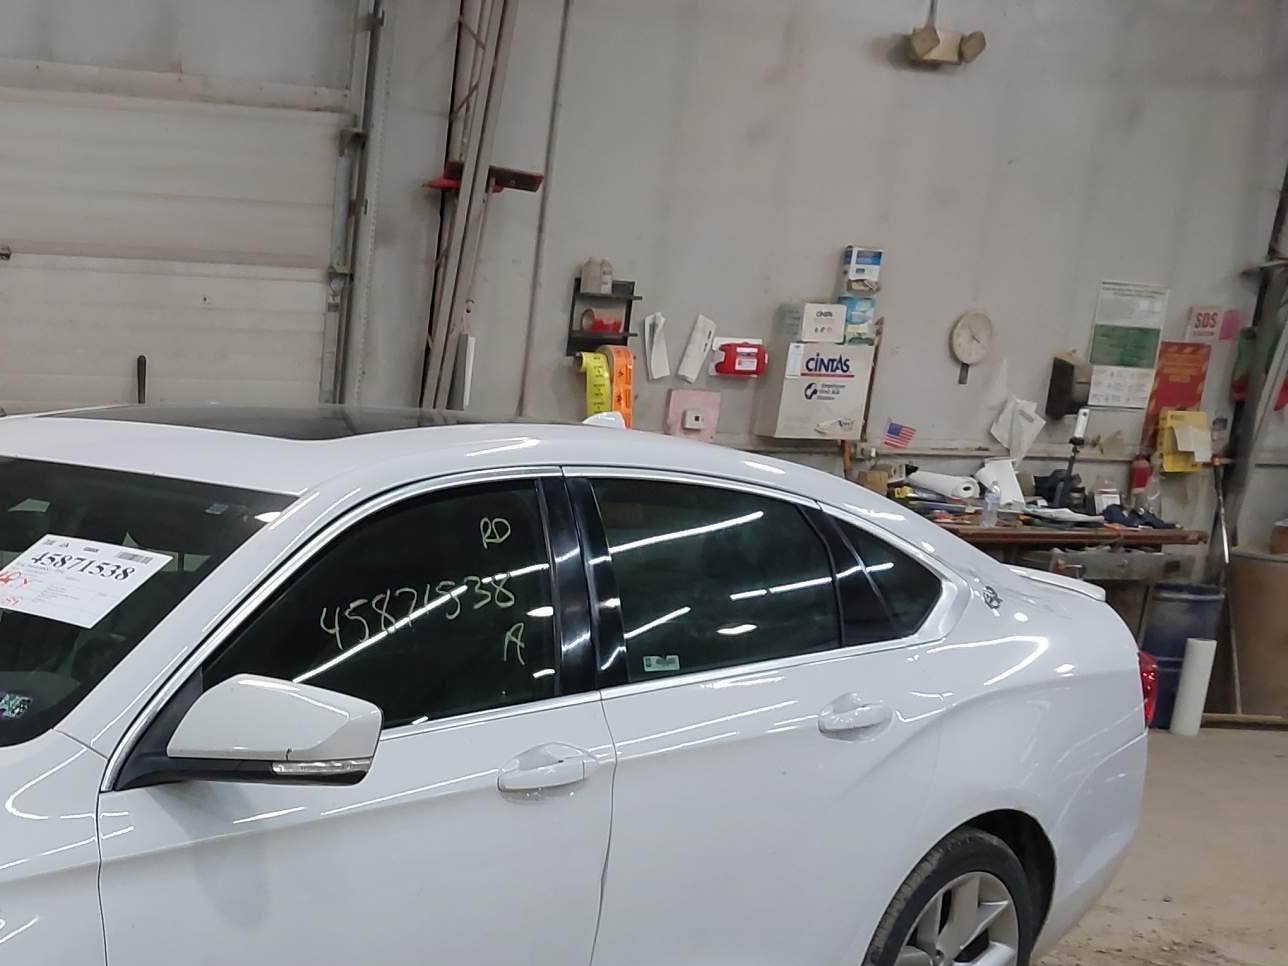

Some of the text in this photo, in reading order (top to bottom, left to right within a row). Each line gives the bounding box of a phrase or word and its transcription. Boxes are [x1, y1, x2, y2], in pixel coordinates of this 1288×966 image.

[1194, 312, 1218, 328] SDS
[805, 352, 850, 373] CINTAS
[31, 551, 136, 581] 45871538
[320, 573, 515, 650] 45871538
